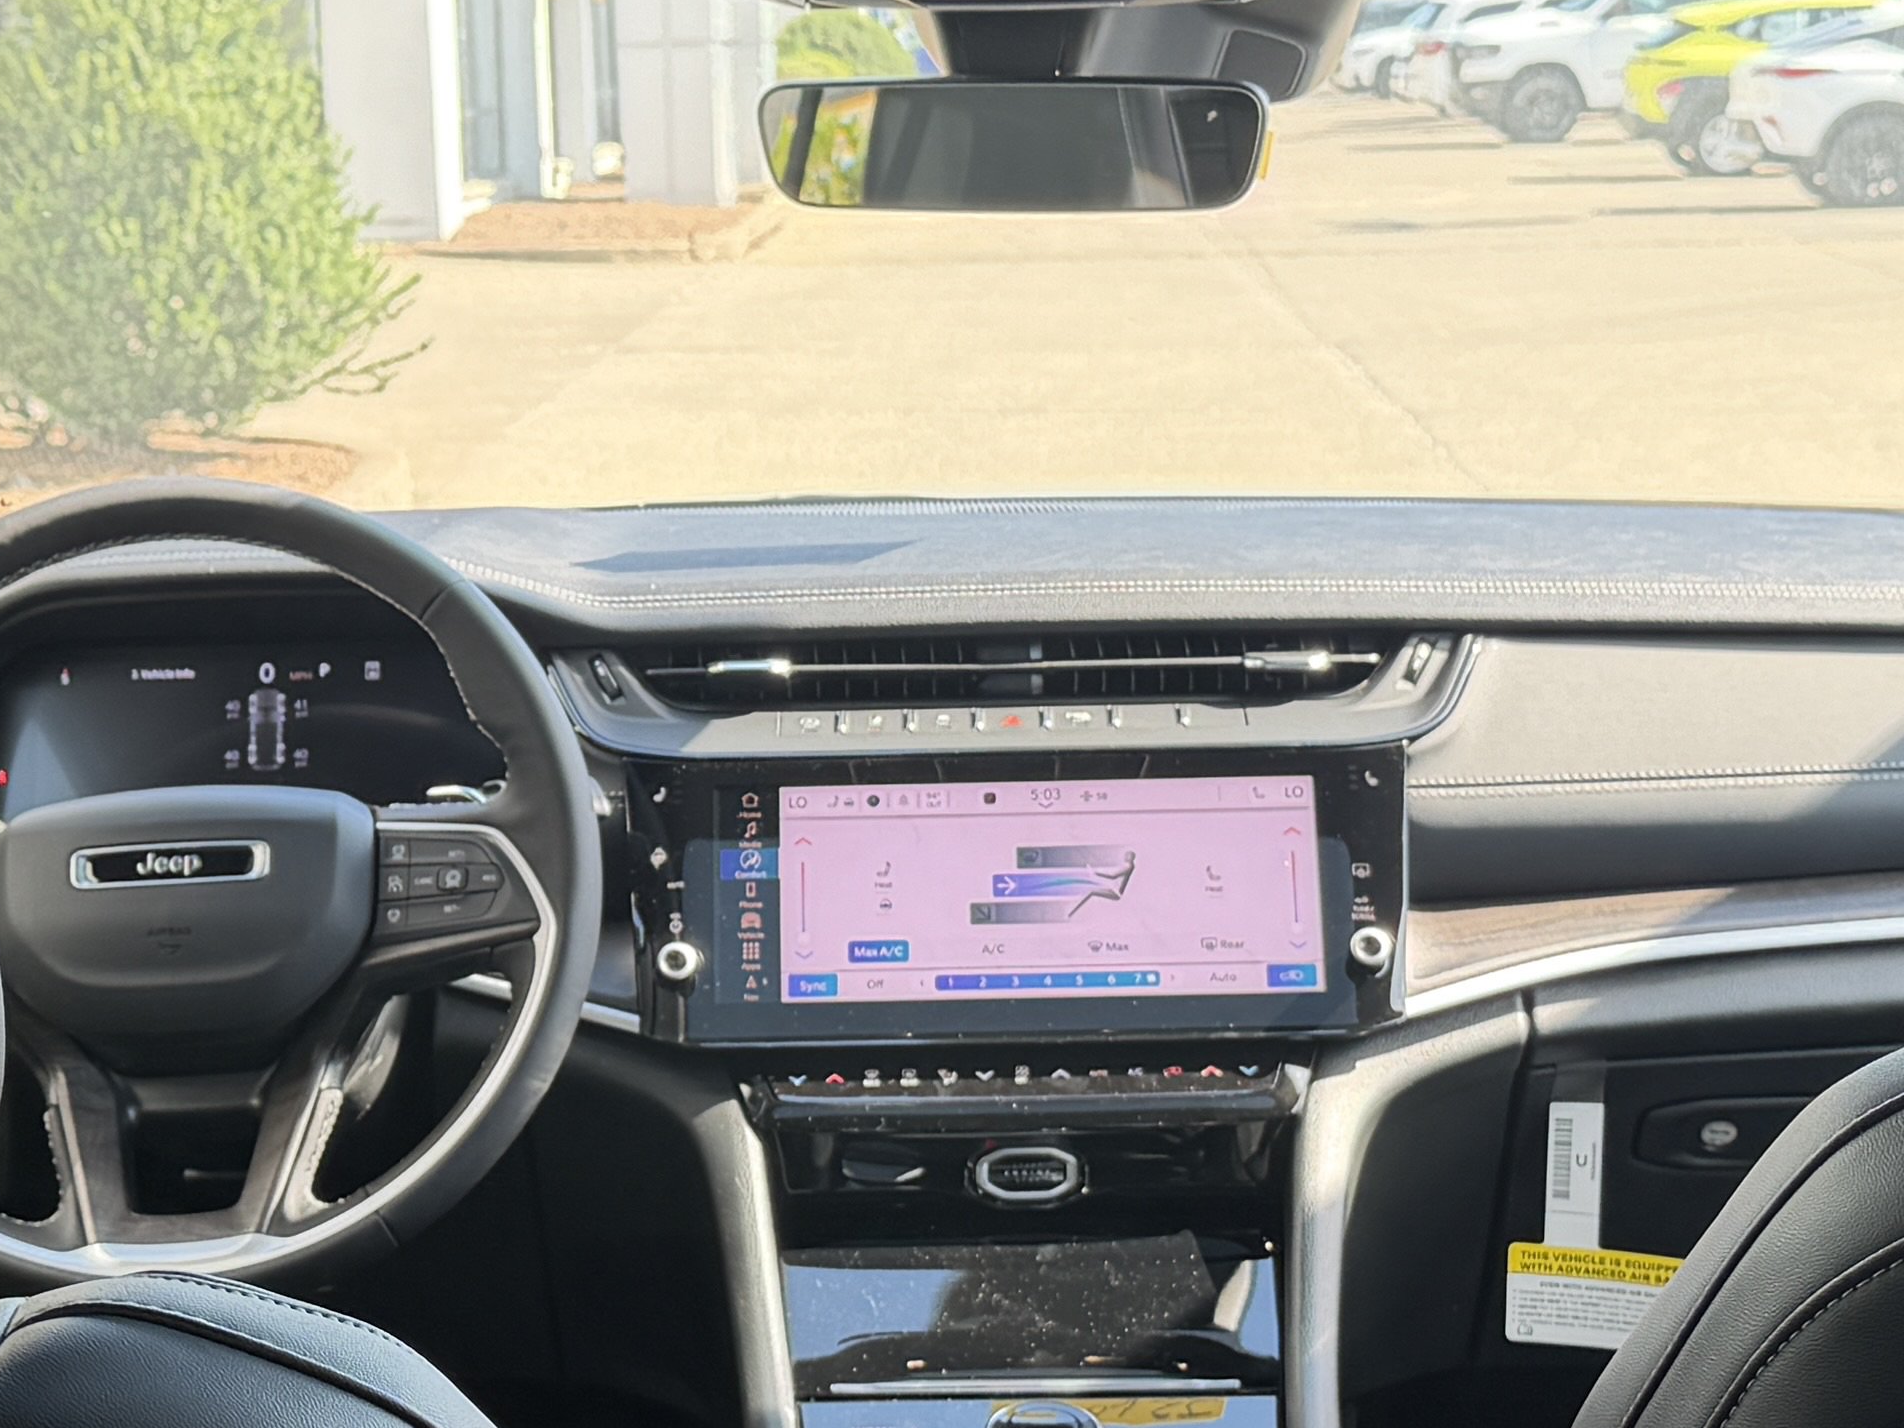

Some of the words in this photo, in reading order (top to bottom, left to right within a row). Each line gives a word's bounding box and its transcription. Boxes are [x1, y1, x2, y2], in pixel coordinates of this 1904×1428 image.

[1030, 788, 1062, 801] 5:03
[1284, 786, 1305, 798] LO
[788, 795, 808, 809] LO
[136, 852, 202, 876] Jeep
[853, 945, 878, 957] Max
[879, 944, 904, 957] A/C
[981, 943, 1006, 954] A/C
[1105, 942, 1130, 952] Max
[1220, 939, 1245, 949] Rear
[866, 978, 885, 989] Off
[978, 976, 988, 987] 2
[1011, 976, 1020, 986] 3
[1043, 975, 1053, 985] 4
[1075, 974, 1084, 985] 5
[1107, 974, 1117, 984] 6
[1133, 973, 1143, 983] 7
[1209, 972, 1237, 982] Auto
[799, 976, 827, 992] Sync
[1521, 1250, 1549, 1261] THIS
[1553, 1253, 1606, 1266] VEHICLE
[1520, 1262, 1553, 1272] WITH
[1557, 1264, 1626, 1280] ADVANCED
[1630, 1271, 1651, 1282] AIR
